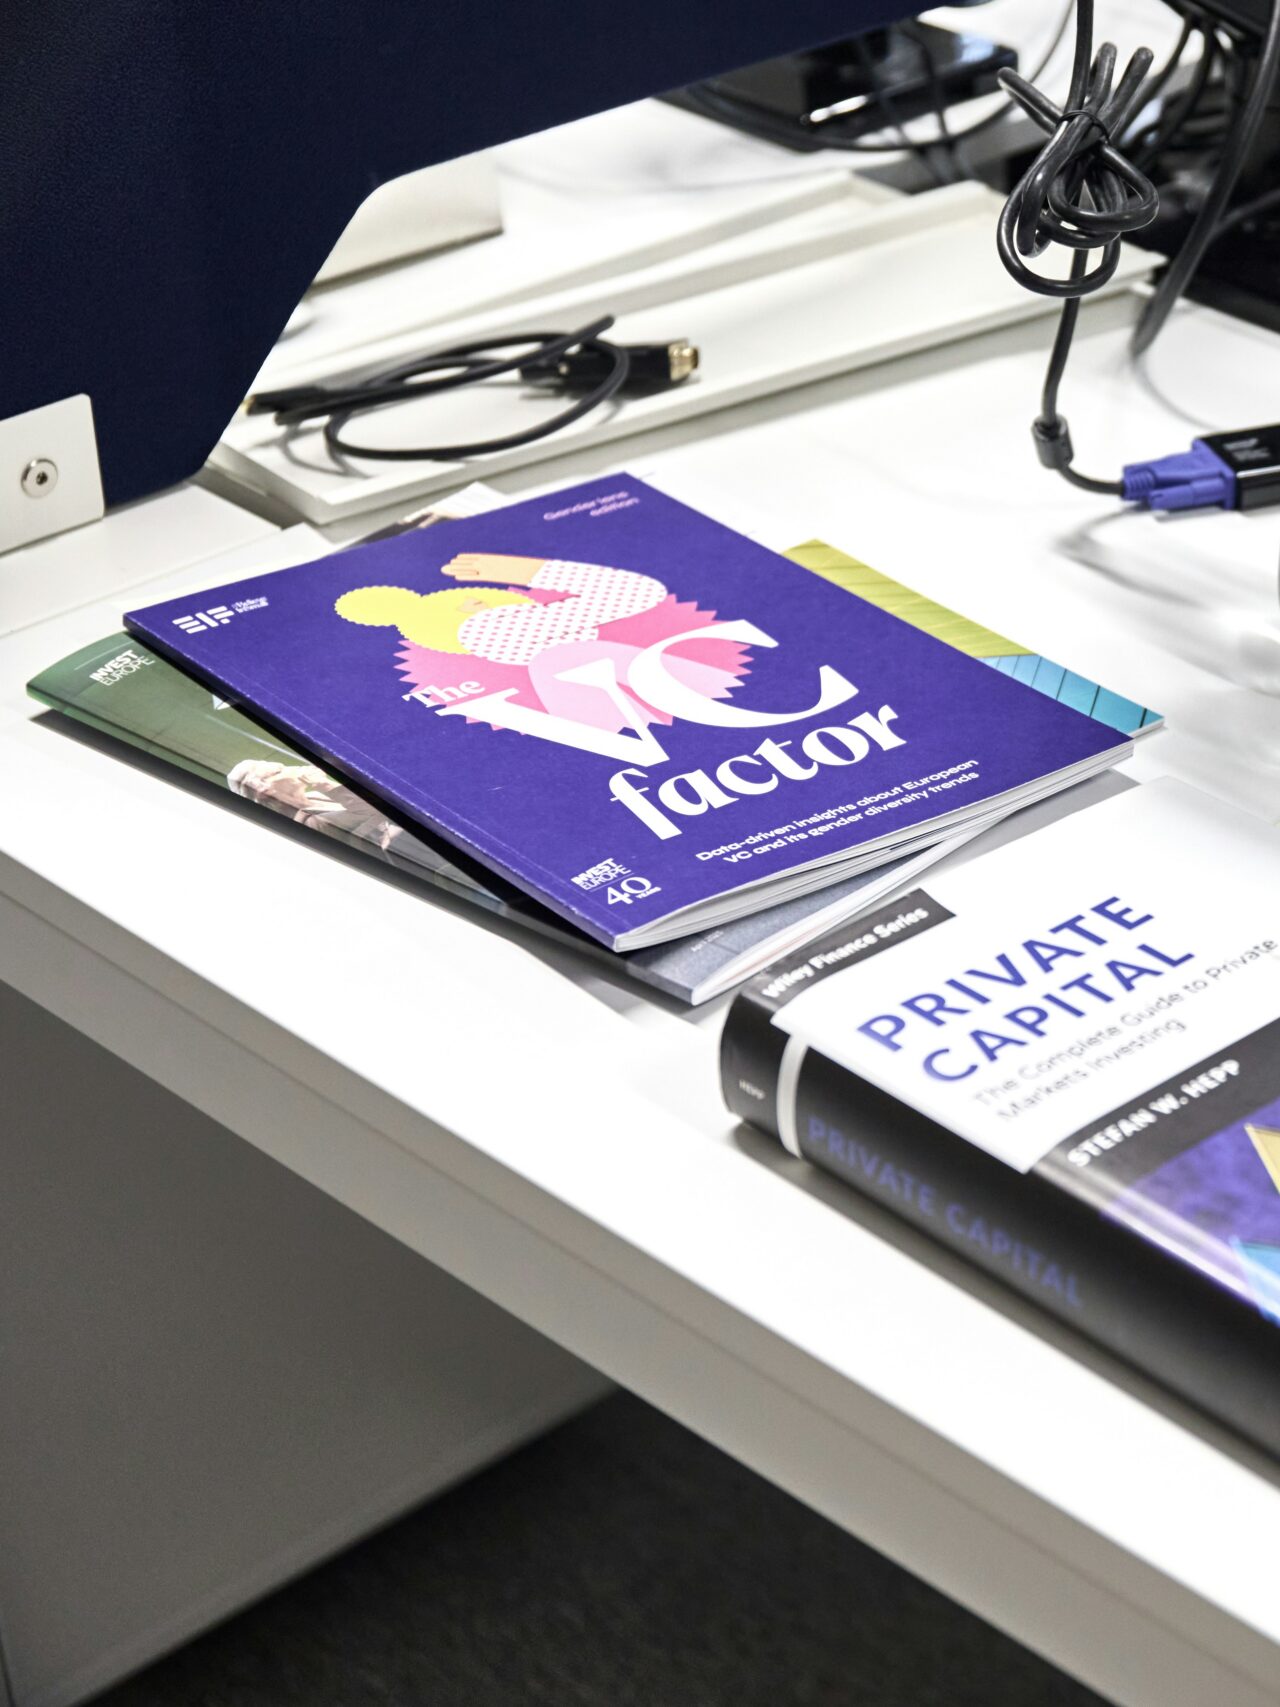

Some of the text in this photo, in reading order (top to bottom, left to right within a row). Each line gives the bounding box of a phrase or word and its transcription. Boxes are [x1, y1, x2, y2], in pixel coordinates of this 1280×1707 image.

[89, 649, 139, 681] INVEST
[99, 655, 155, 686] EUROPE
[402, 680, 486, 710] The
[435, 618, 860, 767] VC
[608, 704, 908, 840] factor
[695, 759, 979, 861] Data-driven insights about European
[723, 771, 980, 863] VC and its gender diversity trends
[570, 858, 618, 885] INVEST
[579, 864, 632, 890] EUROPE
[607, 876, 652, 905] 40
[761, 907, 929, 998] Wiley Finance Series
[856, 896, 1154, 1052] PRIVATE
[922, 943, 1195, 1082] CAPITAL
[1016, 1024, 1122, 1081] Complete
[1120, 991, 1184, 1027] Guide
[1182, 977, 1208, 994] to
[1204, 939, 1279, 980] Private
[996, 1017, 1188, 1121] Markets Investing
[1067, 1059, 1240, 1167] STEFAN W. HEPP
[808, 1115, 1082, 1308] PRIVATE CAPITAL
